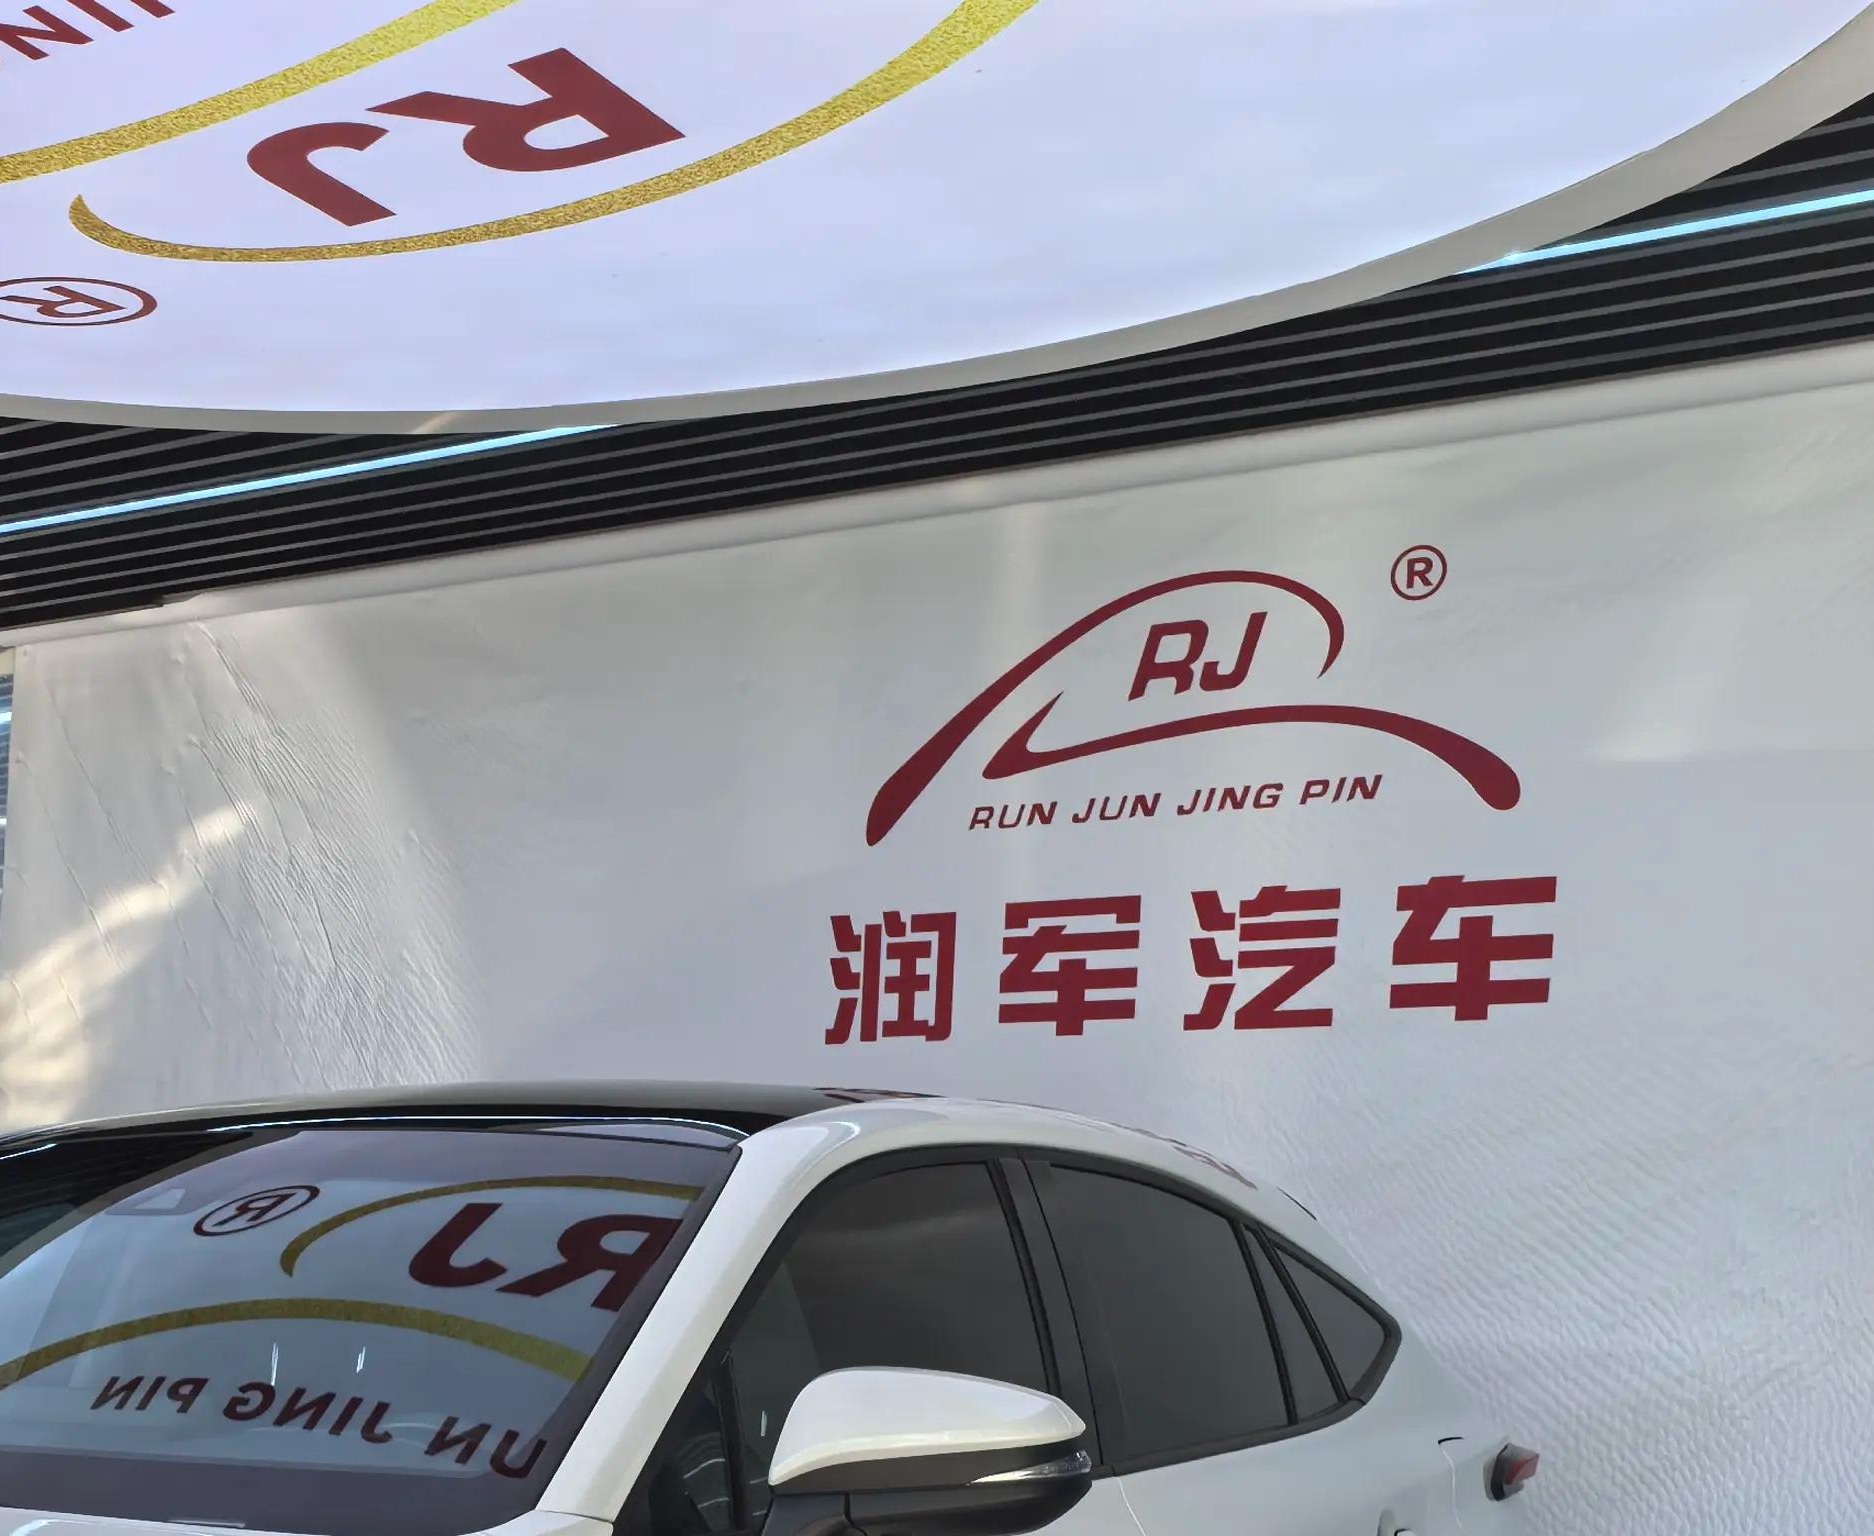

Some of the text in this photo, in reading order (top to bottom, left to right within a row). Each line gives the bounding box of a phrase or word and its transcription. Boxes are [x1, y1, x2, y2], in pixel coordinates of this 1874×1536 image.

[248, 48, 683, 227] RJ
[1128, 611, 1268, 702] RJ
[968, 773, 1383, 831] RUN JUN JING PIN
[825, 874, 1558, 1046] 润军汽车
